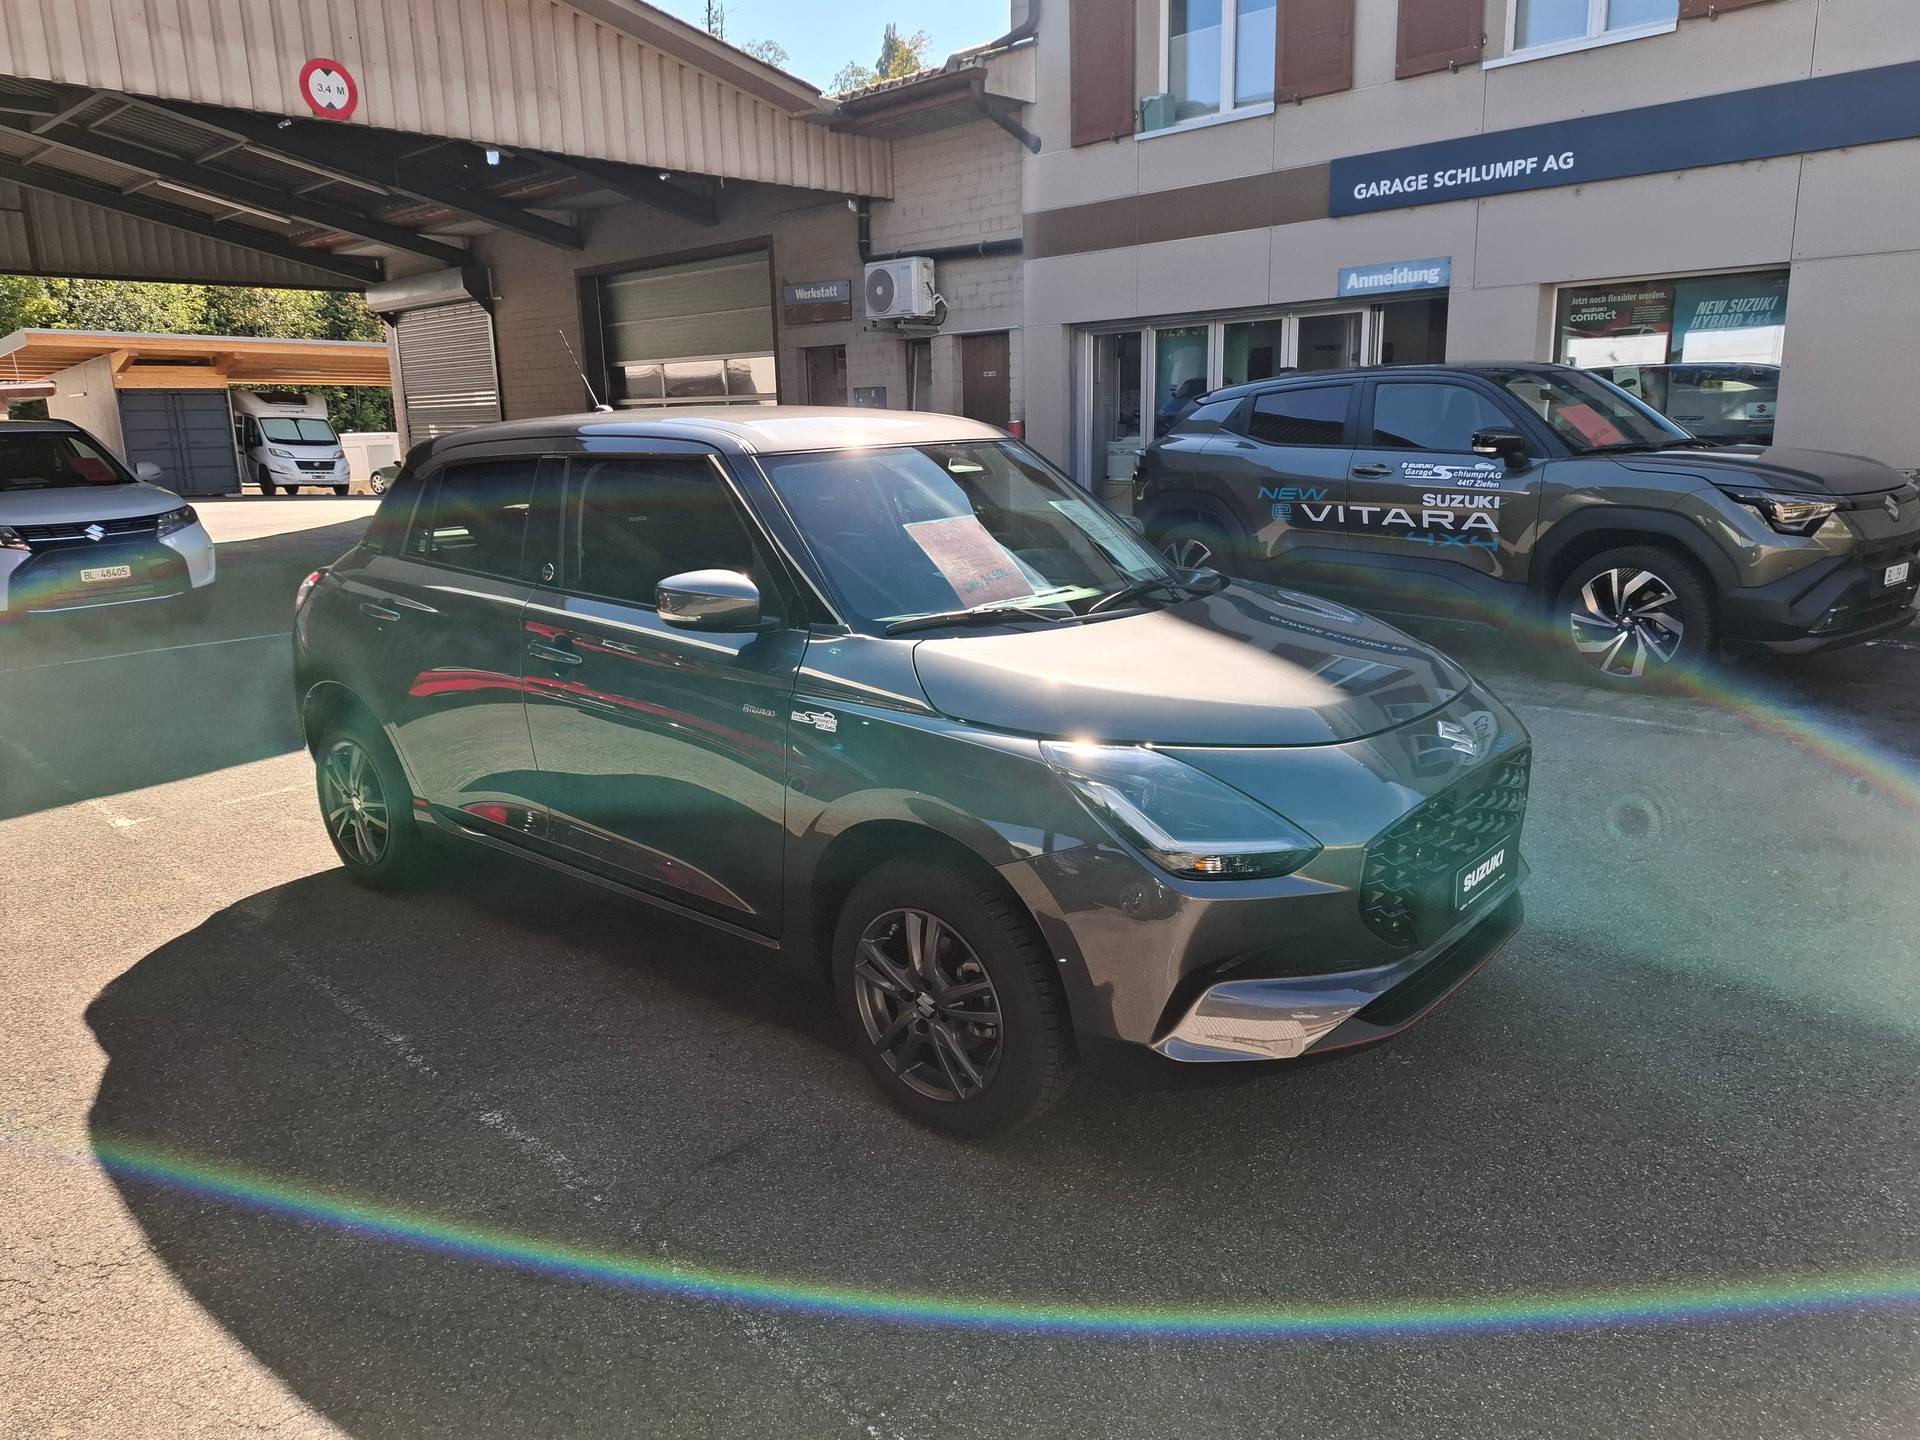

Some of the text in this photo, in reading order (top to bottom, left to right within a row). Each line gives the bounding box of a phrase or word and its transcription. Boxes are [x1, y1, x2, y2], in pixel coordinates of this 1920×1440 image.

[317, 83, 345, 95] 3,4 M
[1353, 151, 1575, 199] GARAGE SCHLUMPF AG
[1346, 266, 1441, 290] Anmeldung
[795, 285, 838, 300] Werkstatt
[1571, 291, 1667, 305] Jetzt noch flexibler werden.
[1696, 296, 1779, 315] NEW SUZUKI
[1570, 310, 1617, 322] connect
[1689, 311, 1772, 329] HYBRID 4x4
[1405, 468, 1433, 476] Garage
[1474, 480, 1500, 488] Ziefen
[1257, 487, 1329, 500] NEW
[1422, 493, 1501, 509] SUZUKI
[1300, 503, 1500, 533] VITARA
[84, 567, 127, 580] BL 48405
[1463, 848, 1505, 893] SUZUKI
